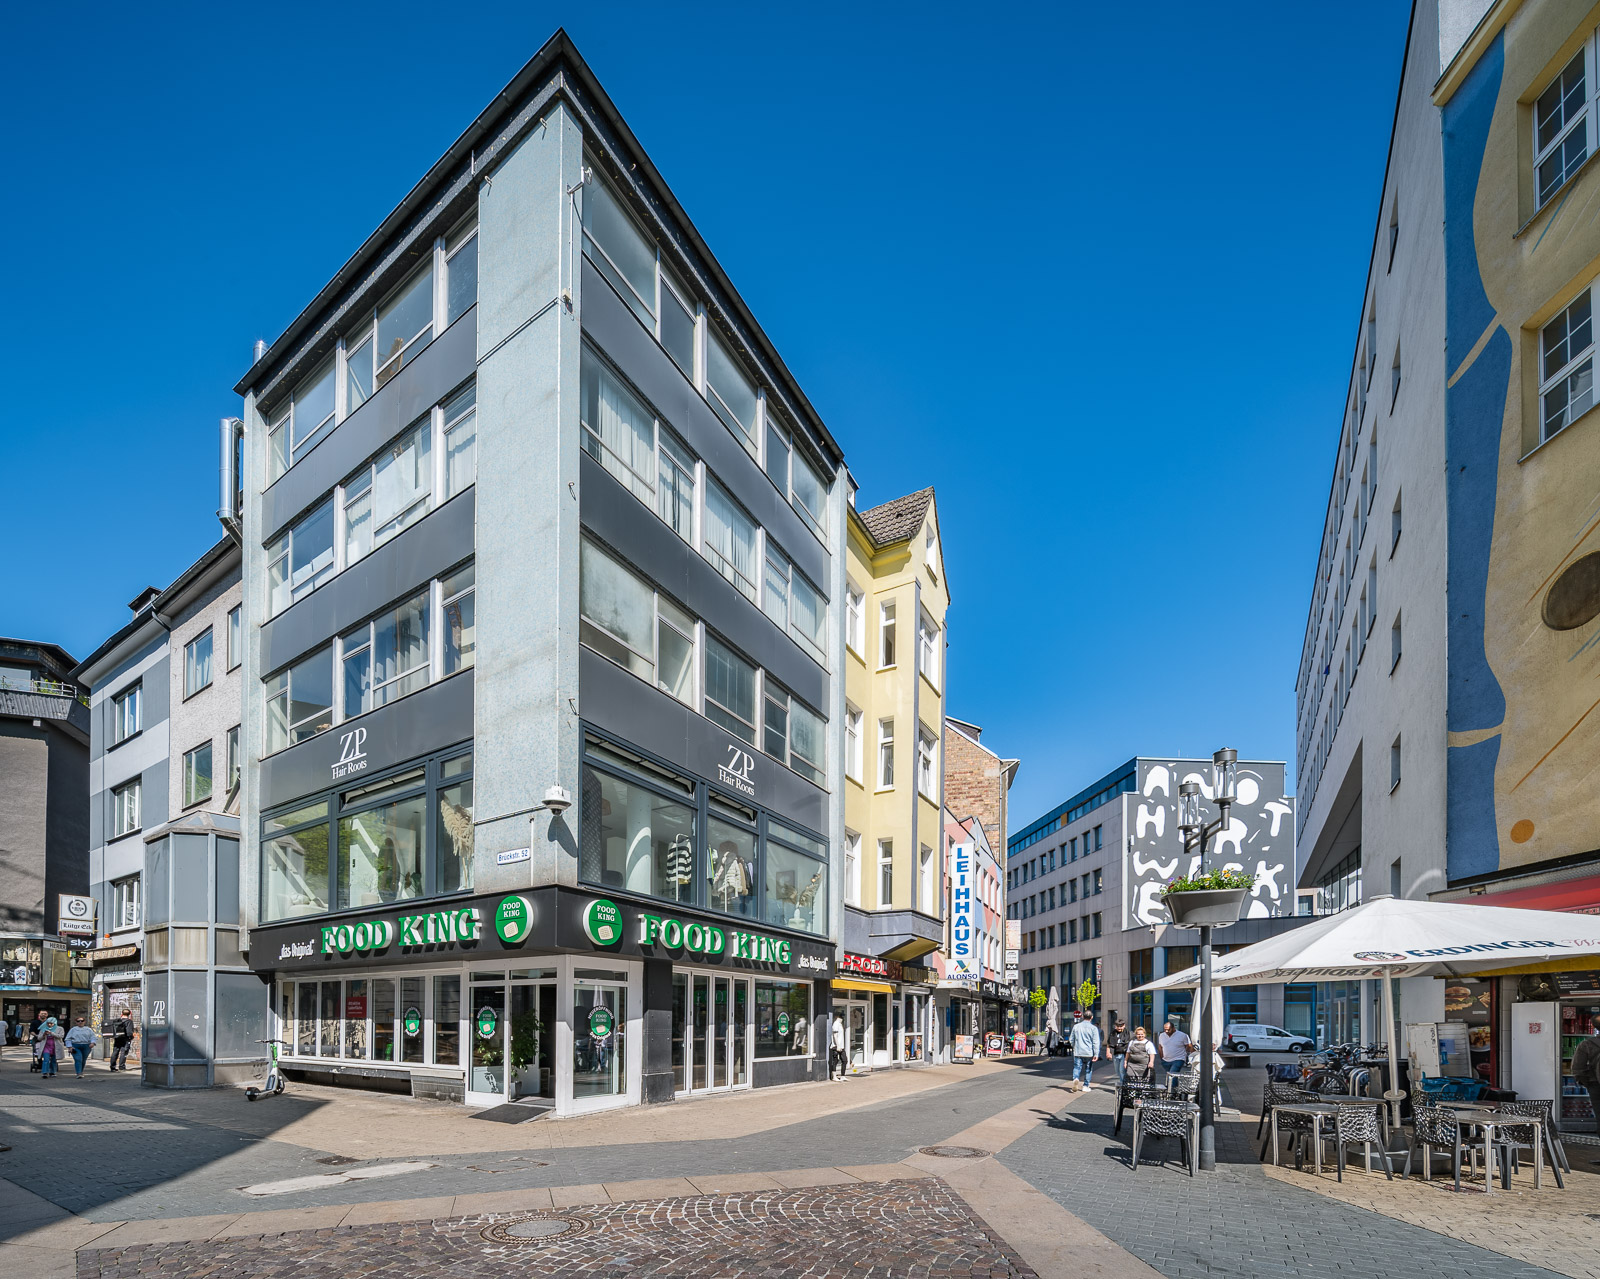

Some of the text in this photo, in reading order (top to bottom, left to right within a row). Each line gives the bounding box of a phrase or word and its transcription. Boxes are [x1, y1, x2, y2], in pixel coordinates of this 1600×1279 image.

[339, 727, 367, 762] ZP
[332, 760, 367, 779] Hair Roots
[727, 744, 755, 780] ZP
[718, 769, 755, 796] Hair Roots
[498, 849, 528, 862] Brückstr. 52
[502, 901, 521, 910] FOOD
[596, 904, 616, 915] FOOD
[954, 847, 970, 956] LEIHHAUS
[503, 908, 520, 918] KING
[597, 912, 615, 922] KING
[320, 920, 393, 954] FOOD
[398, 908, 483, 947] KING
[638, 913, 725, 954] FOOD
[731, 931, 792, 965] KING
[70, 939, 92, 948] sky
[1405, 940, 1569, 957] ERDINGER
[153, 1000, 165, 1016] ZP
